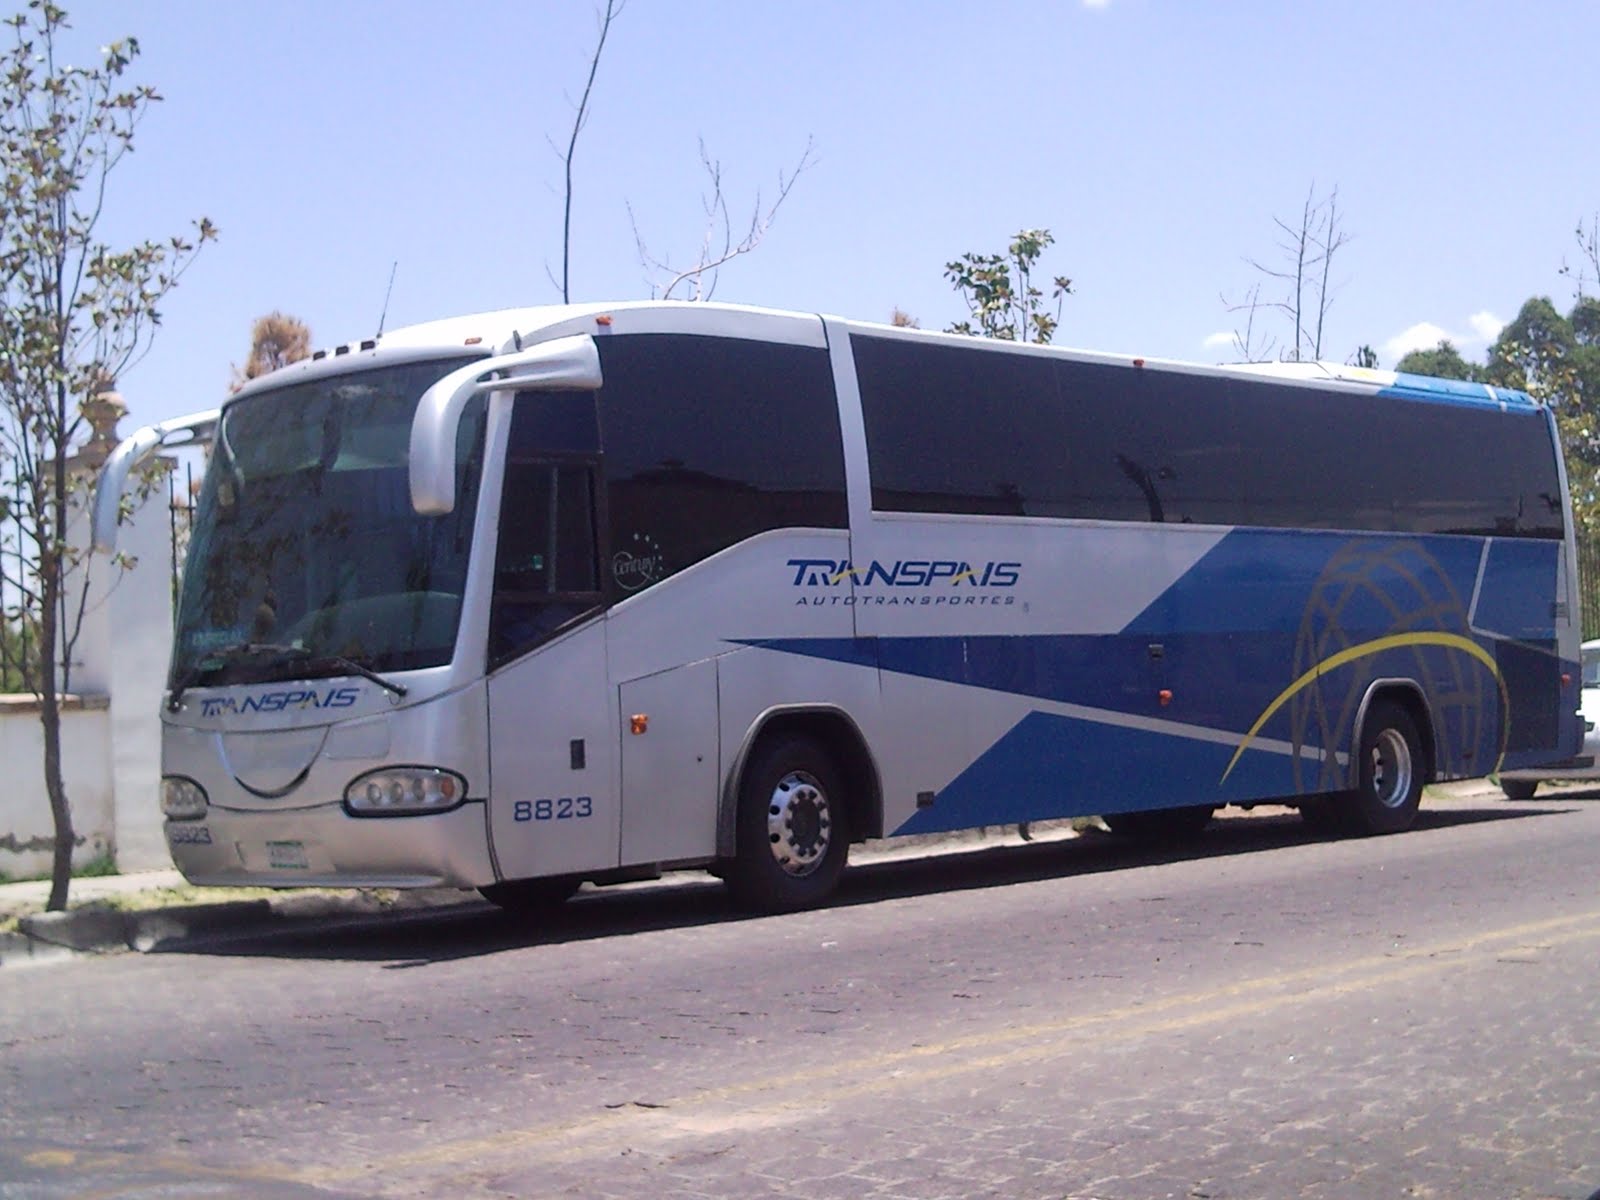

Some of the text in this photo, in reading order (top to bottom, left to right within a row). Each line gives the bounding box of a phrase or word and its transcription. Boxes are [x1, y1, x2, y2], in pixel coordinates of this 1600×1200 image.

[787, 559, 1022, 586] TRANSPAIS
[795, 596, 1015, 606] AUTOTRANSPORTES
[514, 796, 592, 821] 8823
